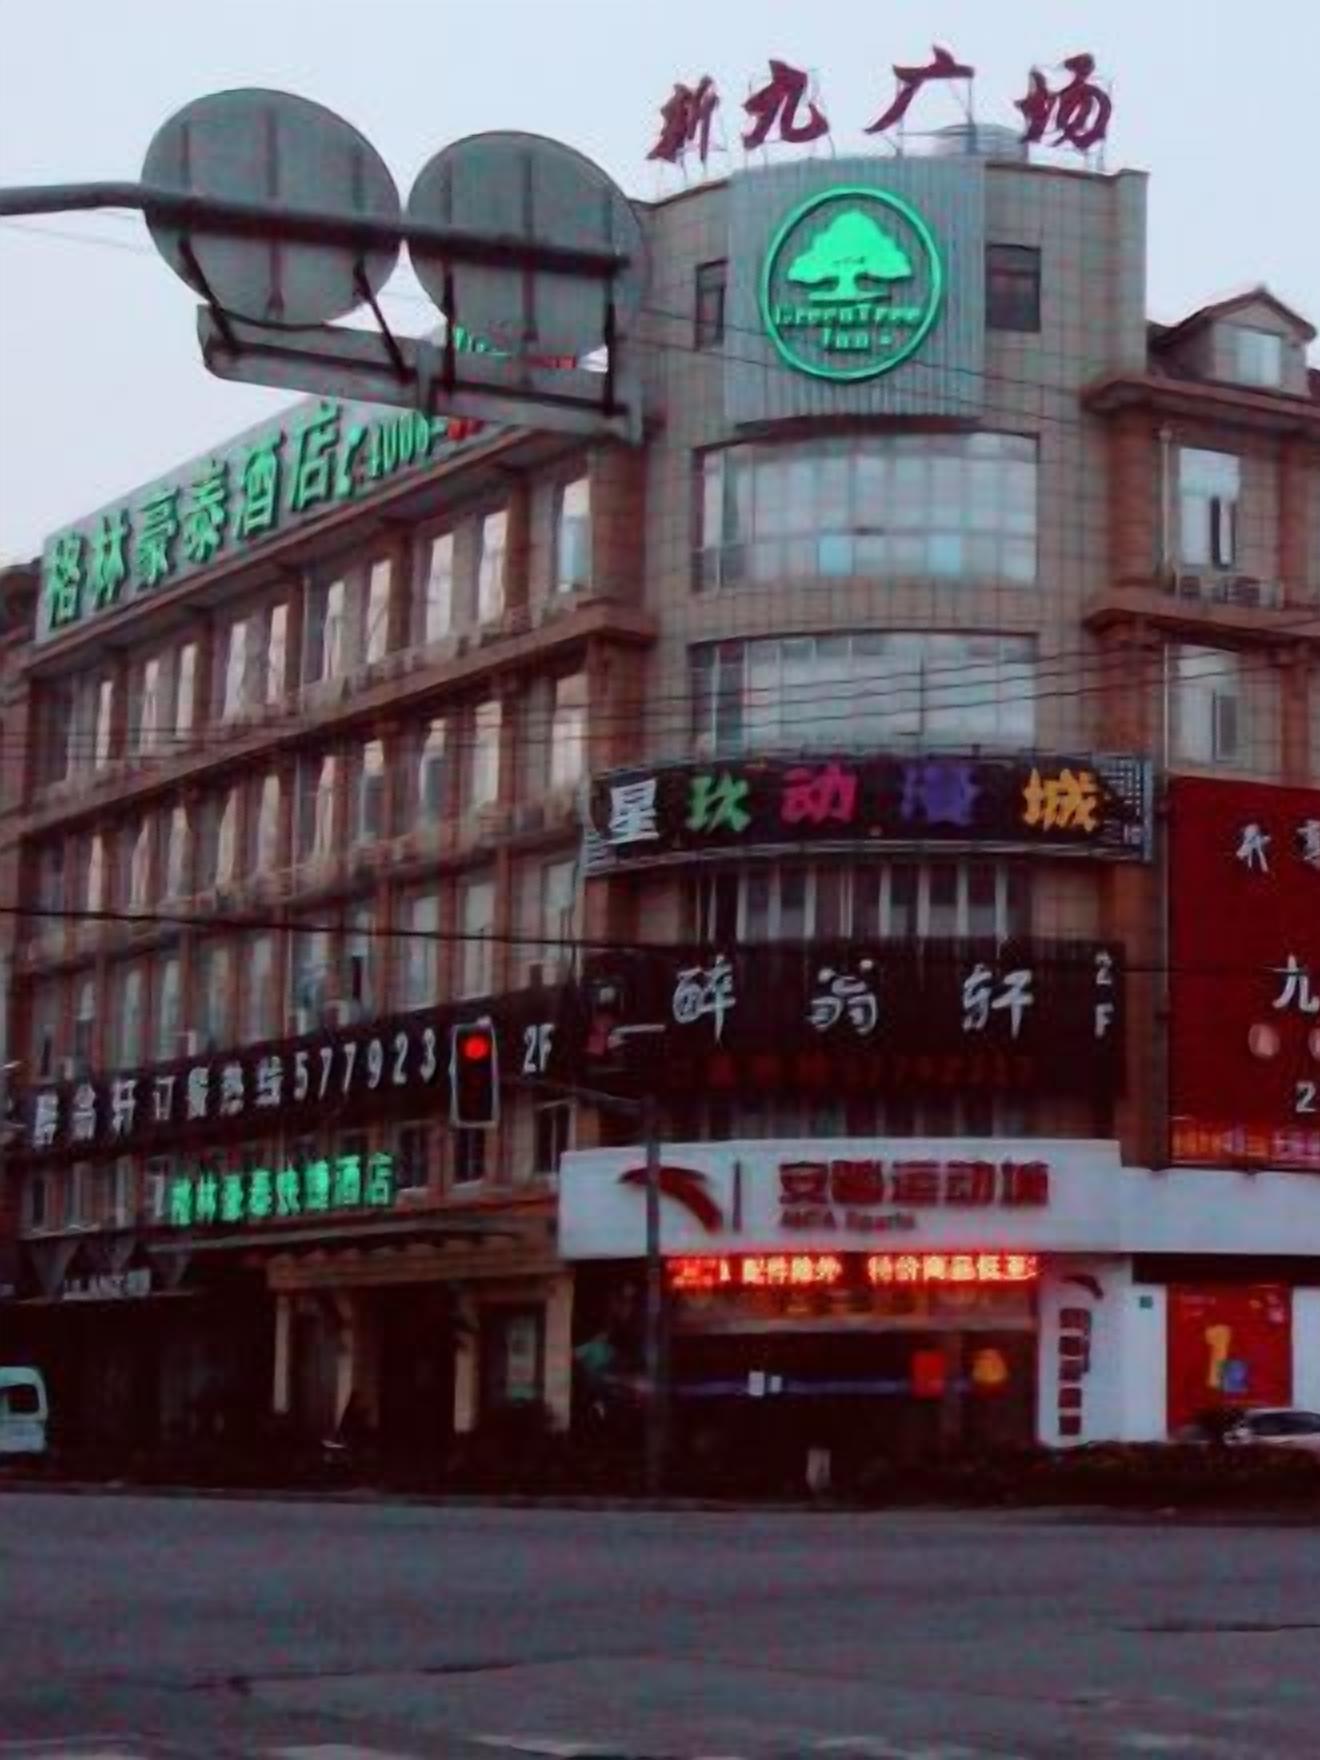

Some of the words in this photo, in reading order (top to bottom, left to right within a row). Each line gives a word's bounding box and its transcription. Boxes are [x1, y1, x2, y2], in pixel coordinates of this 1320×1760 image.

[647, 45, 1113, 163] 新九广场
[45, 398, 342, 632] 格林豪泰酒店
